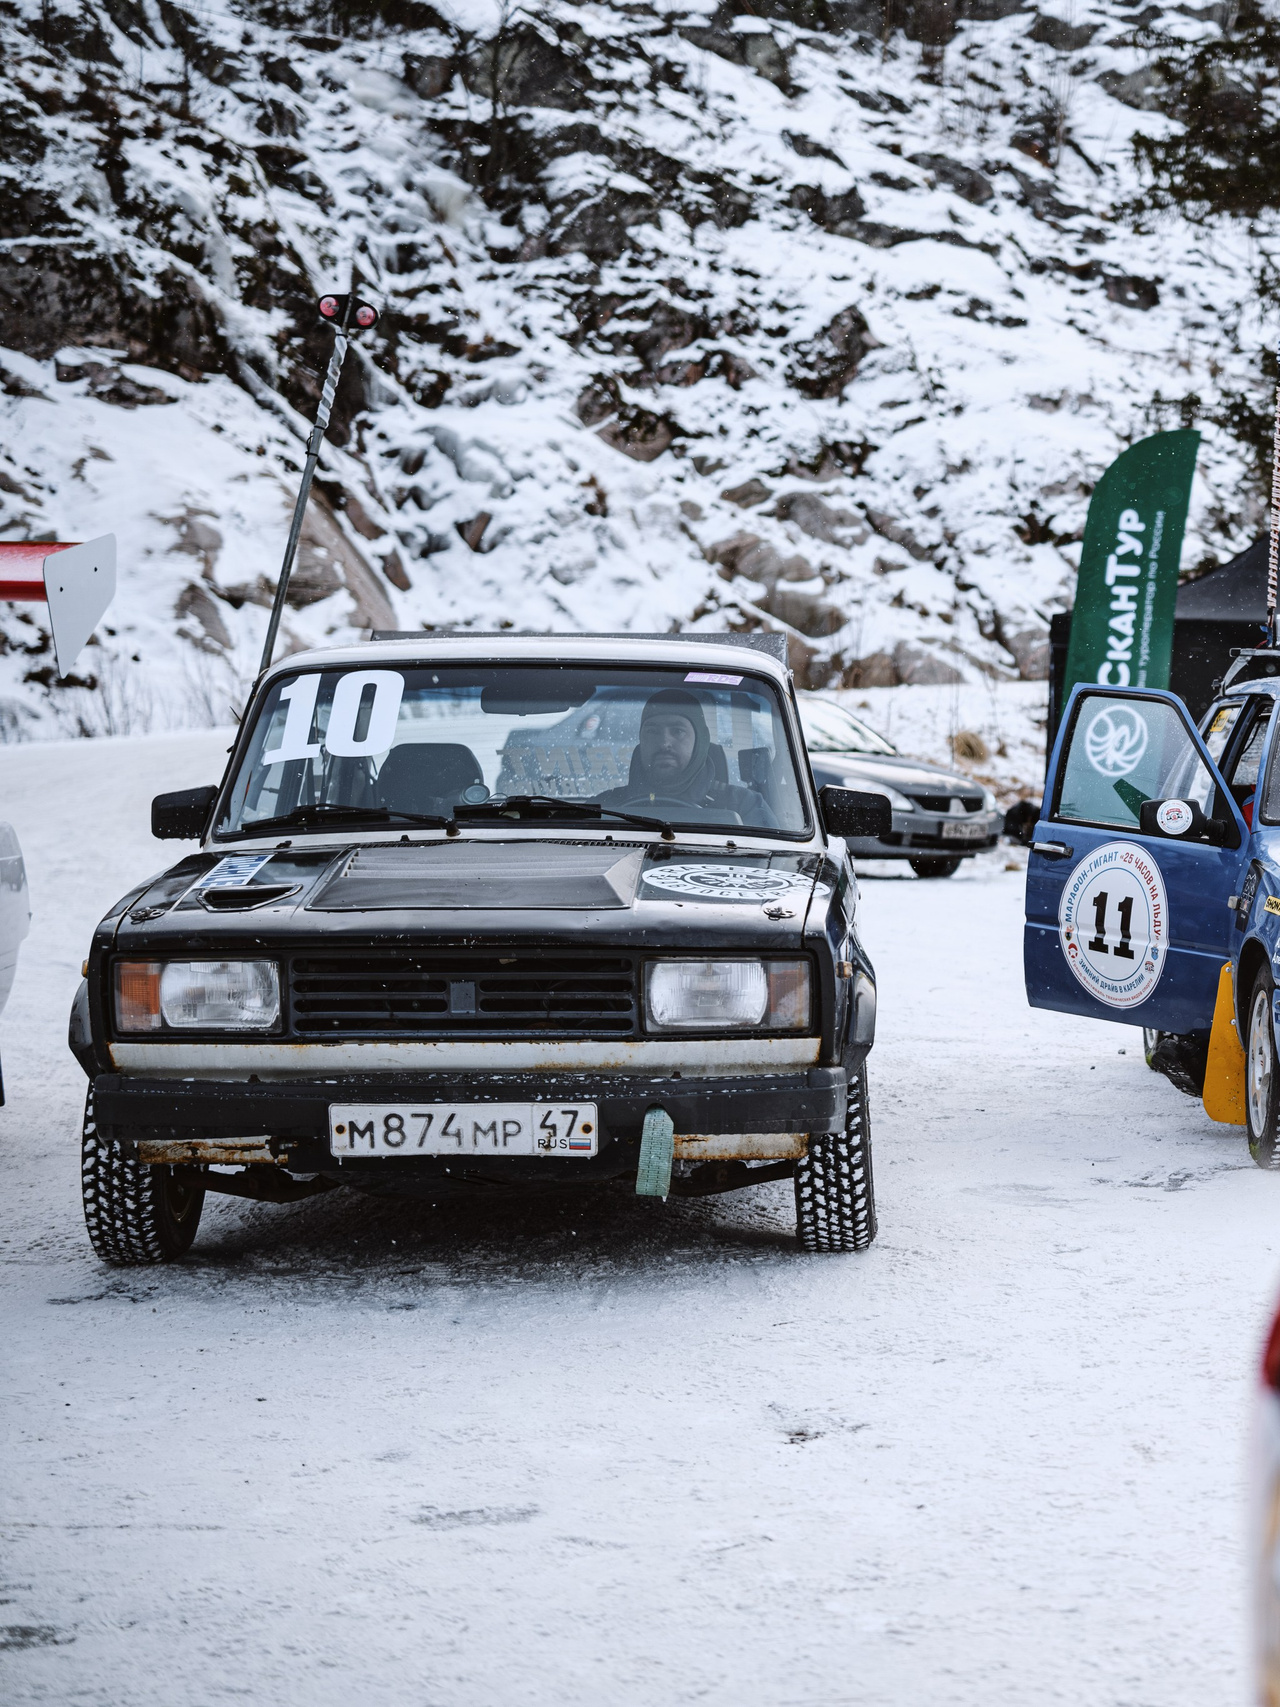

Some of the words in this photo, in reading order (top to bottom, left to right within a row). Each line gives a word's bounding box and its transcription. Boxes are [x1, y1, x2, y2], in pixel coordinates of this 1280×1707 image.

[1148, 510, 1166, 559] России
[1148, 560, 1159, 579] по
[263, 669, 405, 766] 10
[1065, 851, 1119, 923] МАРАФОН-ГИГАНТ
[1134, 856, 1154, 885] ЧАСОВ
[1149, 884, 1159, 901] НА
[1088, 891, 1135, 960] 11
[1078, 958, 1100, 985] ЗИМНИЙ
[1099, 980, 1119, 993] ДРАЙВ
[1119, 985, 1124, 994] В
[1123, 973, 1146, 993] КАРЕЛИИ
[537, 1138, 568, 1149] RUS
[539, 1110, 579, 1138] 47
